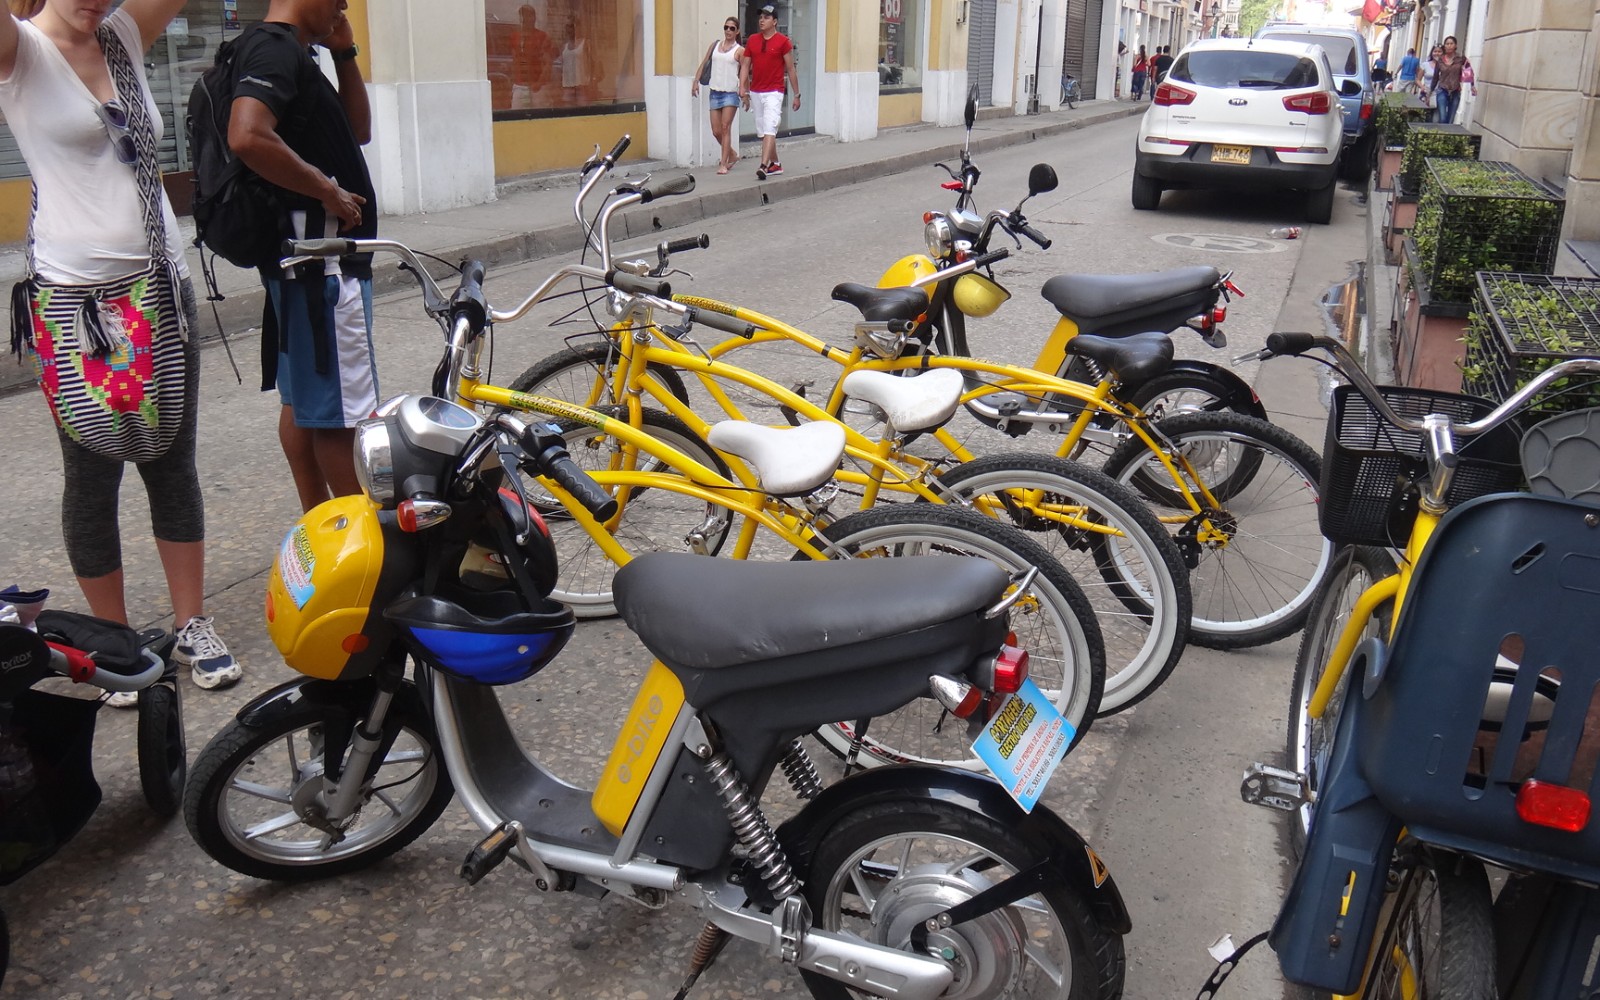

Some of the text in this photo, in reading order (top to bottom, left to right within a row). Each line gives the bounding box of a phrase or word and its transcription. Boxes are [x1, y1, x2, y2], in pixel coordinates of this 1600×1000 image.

[1, 649, 32, 669] britax
[989, 693, 1026, 744] CARTAGENA
[617, 694, 663, 784] e-bike
[998, 728, 1021, 759] ELECTRIC
[1012, 758, 1024, 775] CALLE
[1032, 735, 1039, 744] DE
